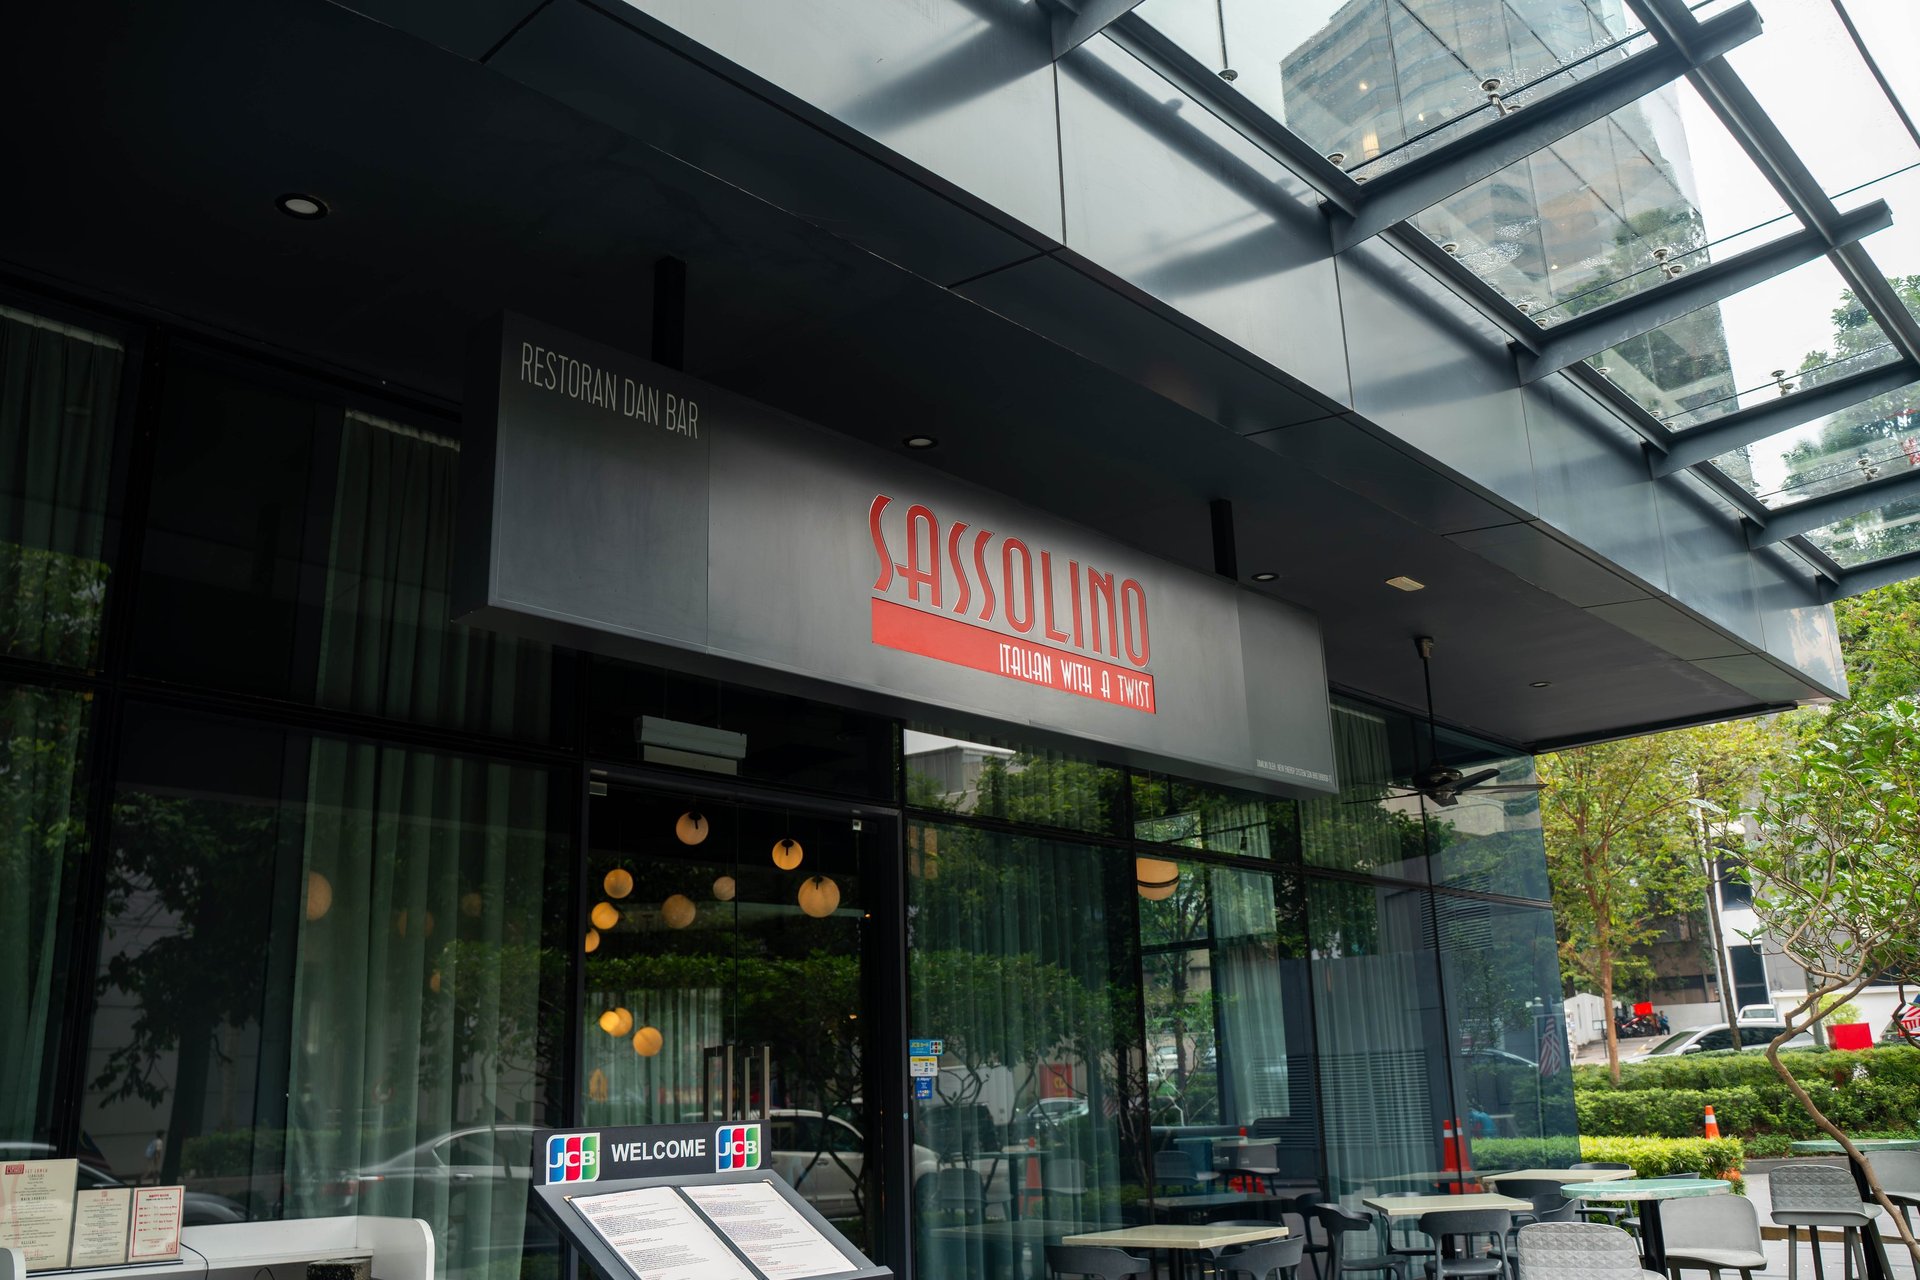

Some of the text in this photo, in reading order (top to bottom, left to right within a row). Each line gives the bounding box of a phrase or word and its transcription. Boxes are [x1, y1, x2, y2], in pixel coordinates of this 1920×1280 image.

[521, 342, 698, 439] RESTORAN DAN BAR
[869, 494, 1151, 668] SASSOLINO
[1000, 643, 1150, 708] ITALIAN WITH A TWIST
[611, 1138, 706, 1162] WELCOME
